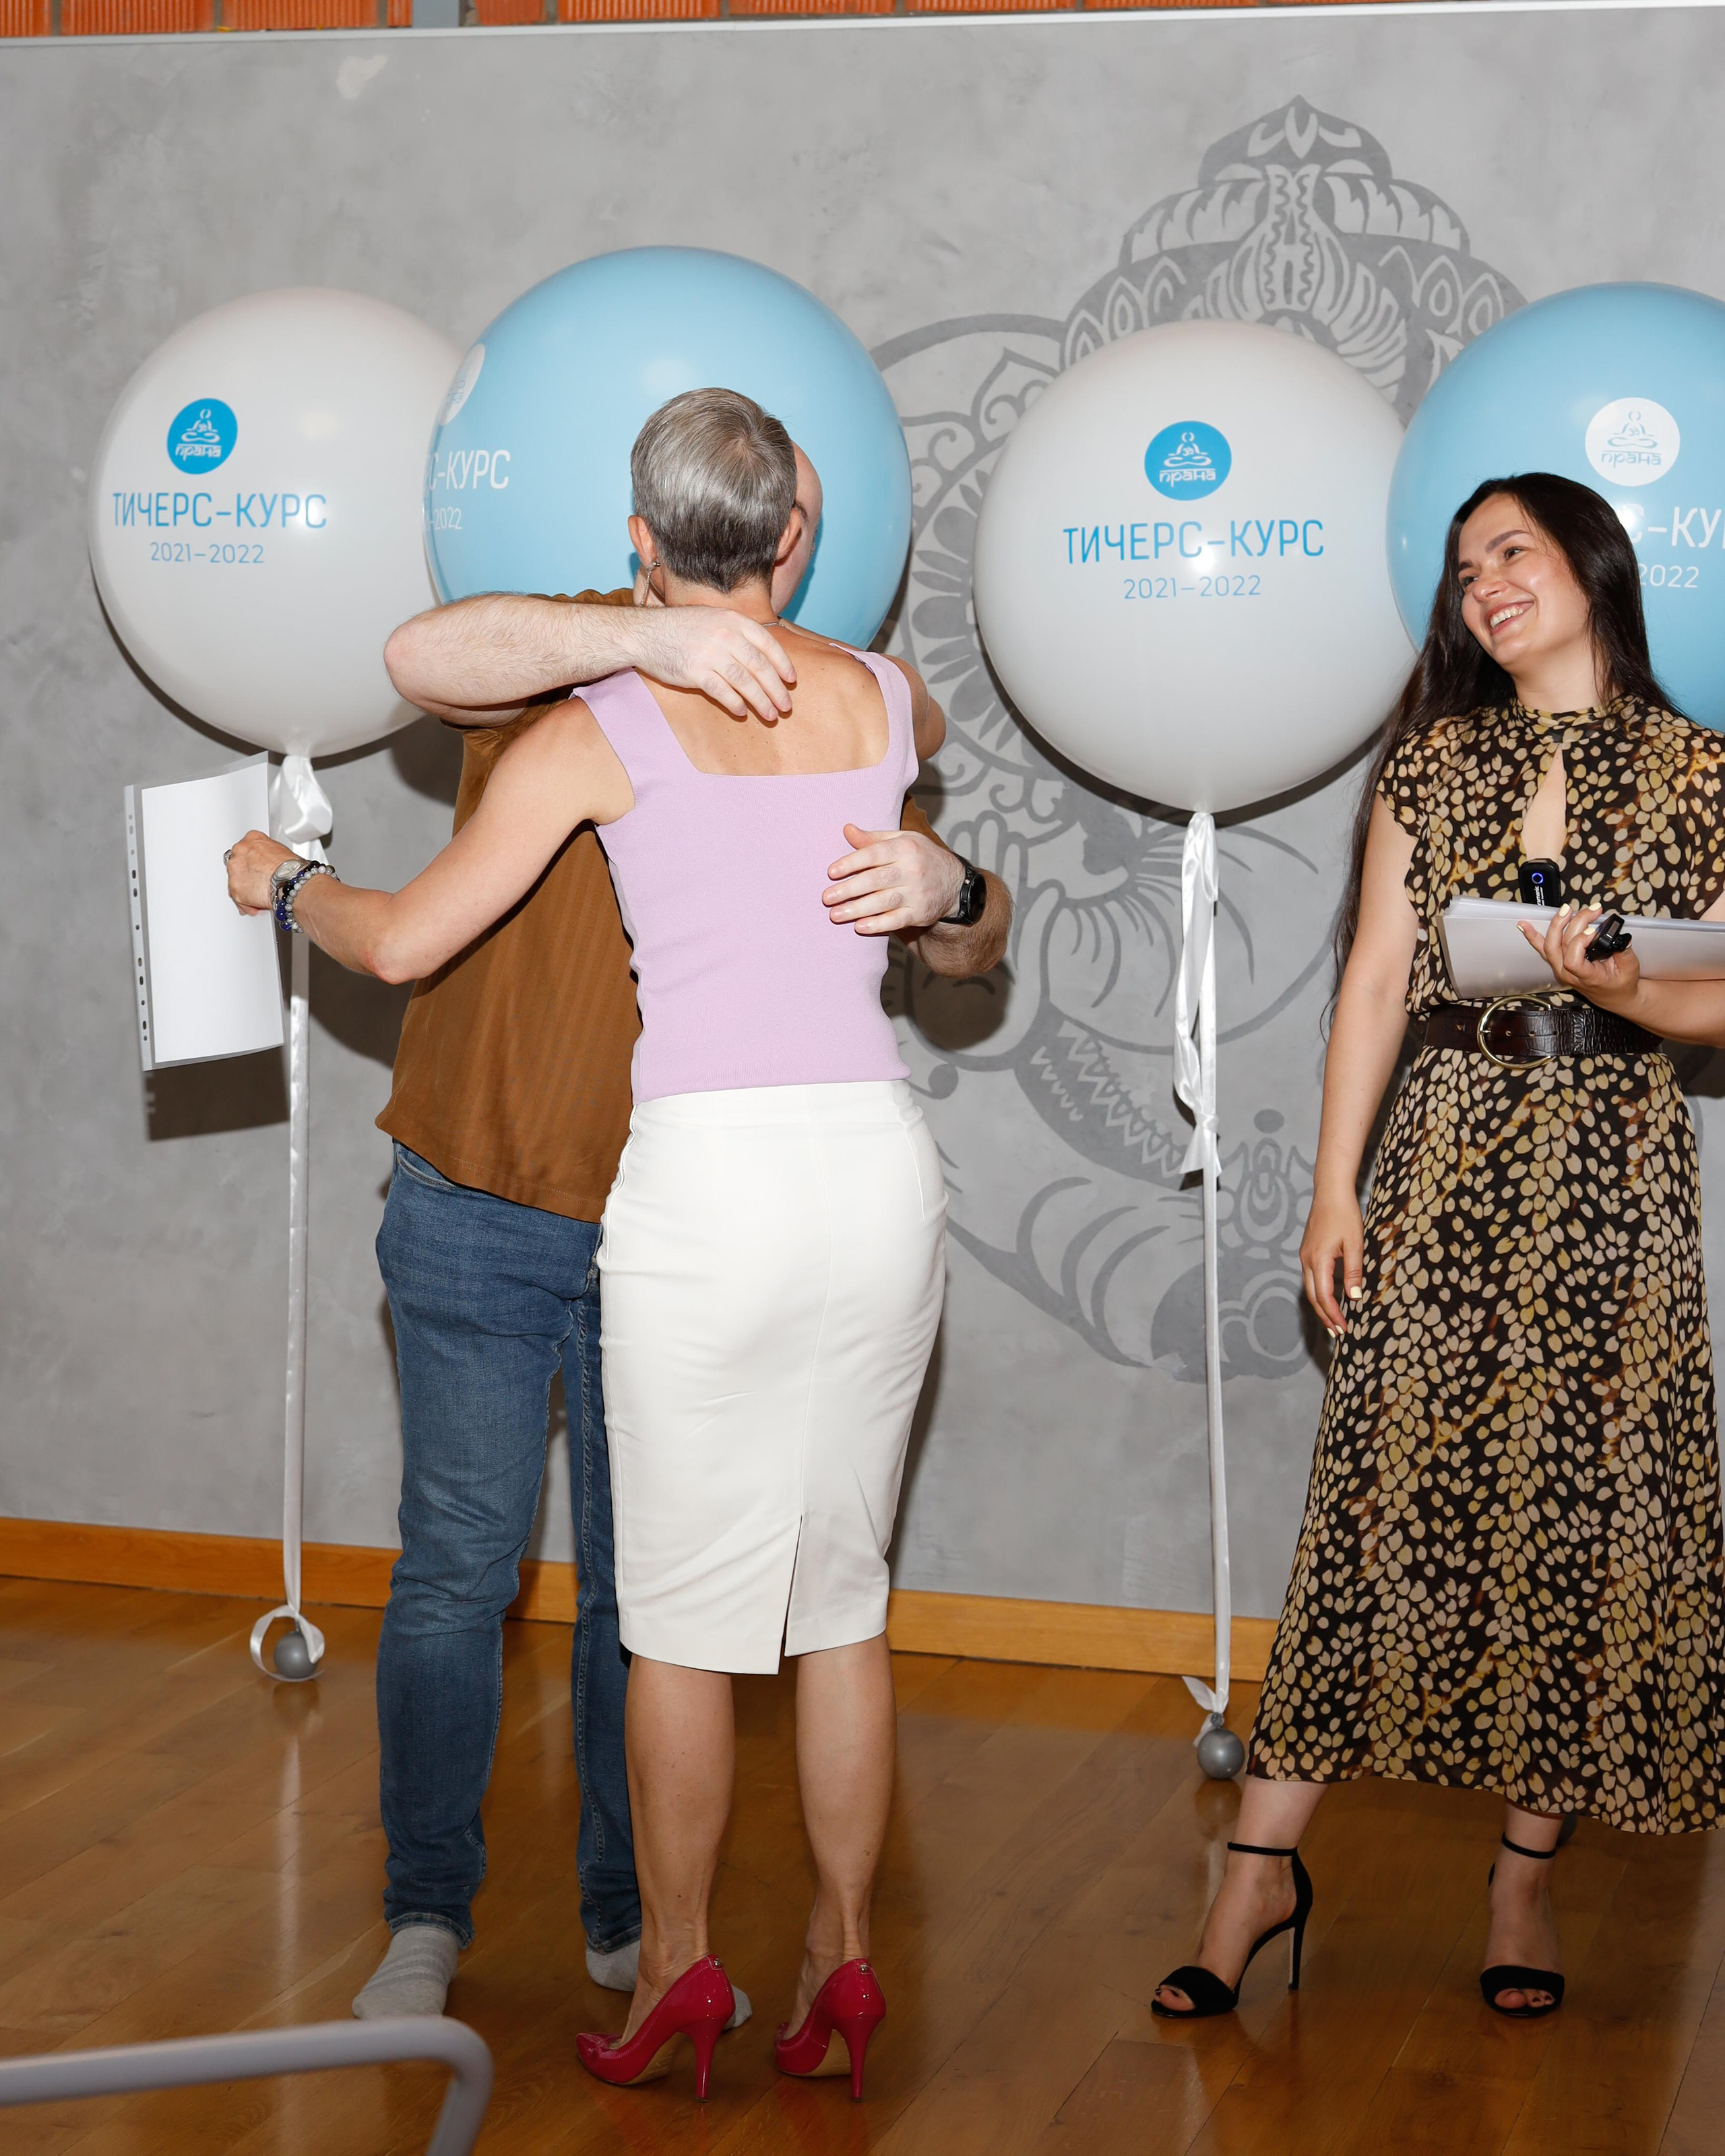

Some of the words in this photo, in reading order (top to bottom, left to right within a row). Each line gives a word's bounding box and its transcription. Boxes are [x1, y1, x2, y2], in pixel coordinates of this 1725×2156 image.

[1601, 450, 1662, 470] прана
[1159, 468, 1216, 487] прана
[113, 493, 327, 528] ТИЧЕРС-КУРС
[1623, 503, 1725, 549] С-КУ
[150, 542, 265, 563] 2021-2022
[1063, 519, 1324, 565] ТИЧЕРС-КУРС
[1123, 575, 1261, 599] 2021-2022
